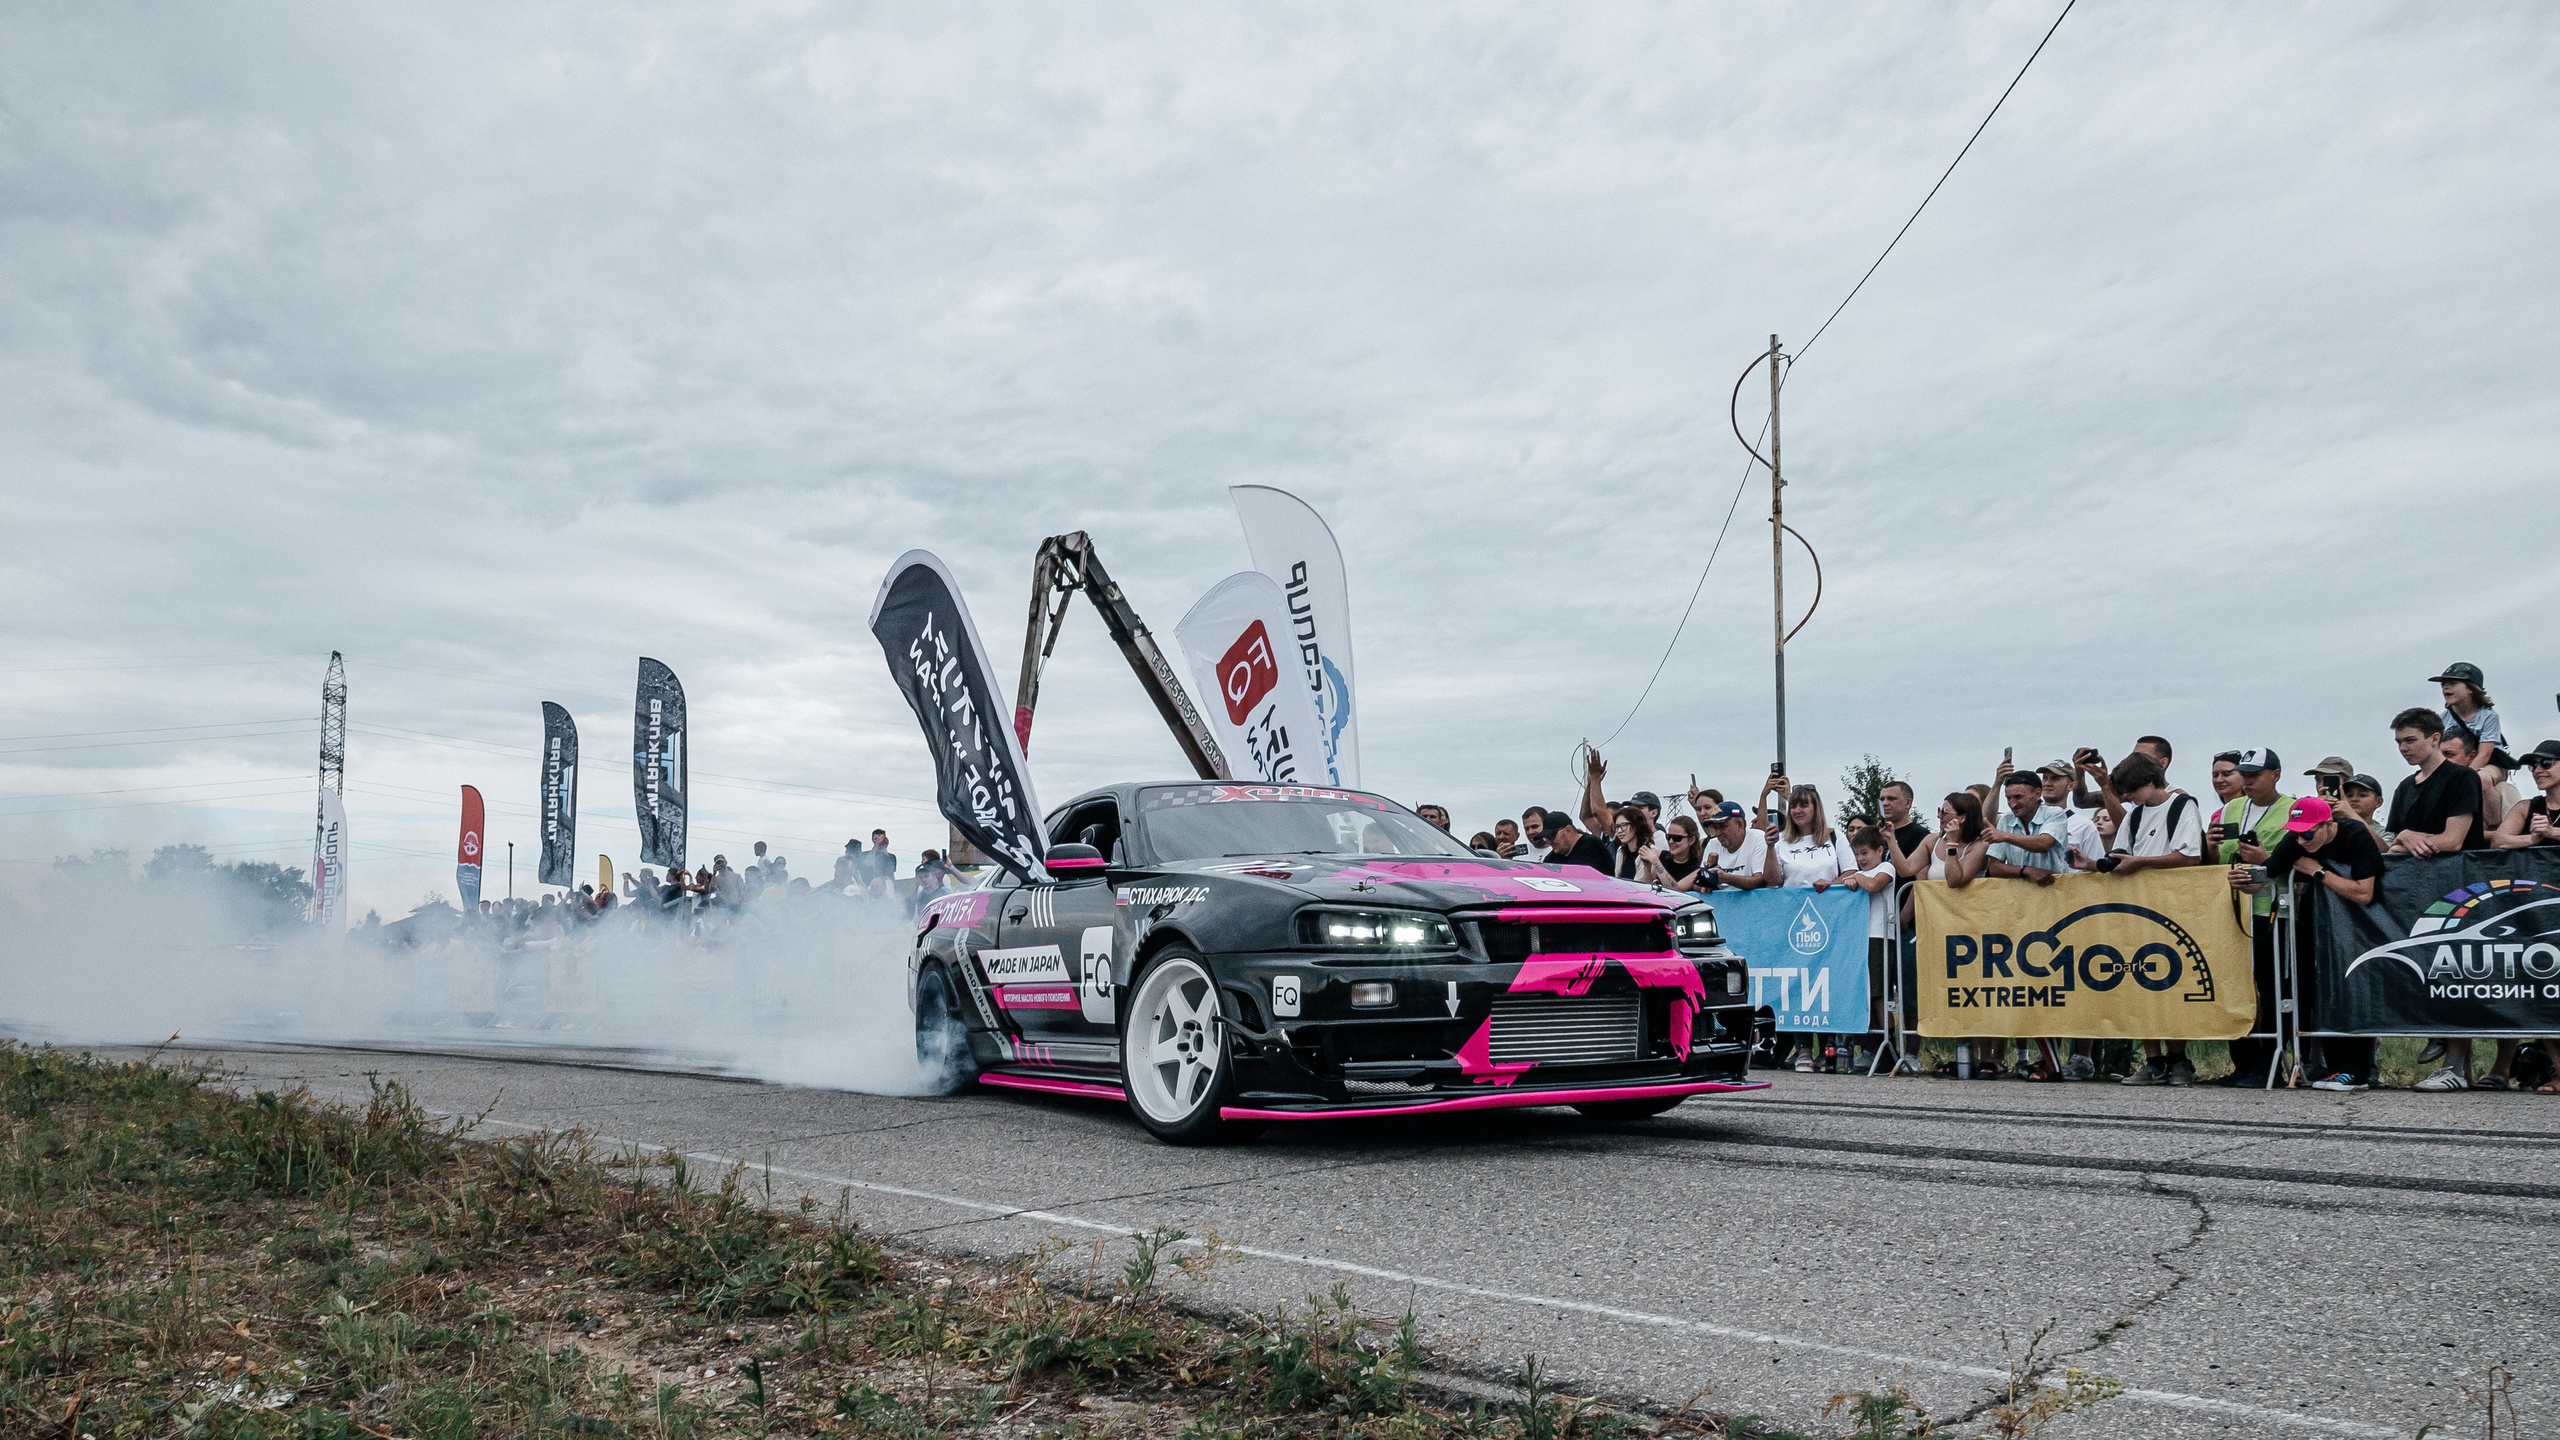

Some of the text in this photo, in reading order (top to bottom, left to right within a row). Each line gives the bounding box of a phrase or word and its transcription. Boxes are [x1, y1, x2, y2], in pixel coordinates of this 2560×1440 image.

[1129, 886, 1188, 905] СТИХАРЮК
[1796, 931, 1821, 943] ПЬЮ
[987, 954, 1061, 974] MADE IN JAPAN
[2112, 961, 2149, 976] park
[1083, 953, 1112, 998] FQ
[1275, 986, 1298, 1006] FQ
[1947, 985, 2067, 1008] EXTREME
[2430, 984, 2535, 999] магазин
[1793, 1015, 1829, 1027] ВОДА
